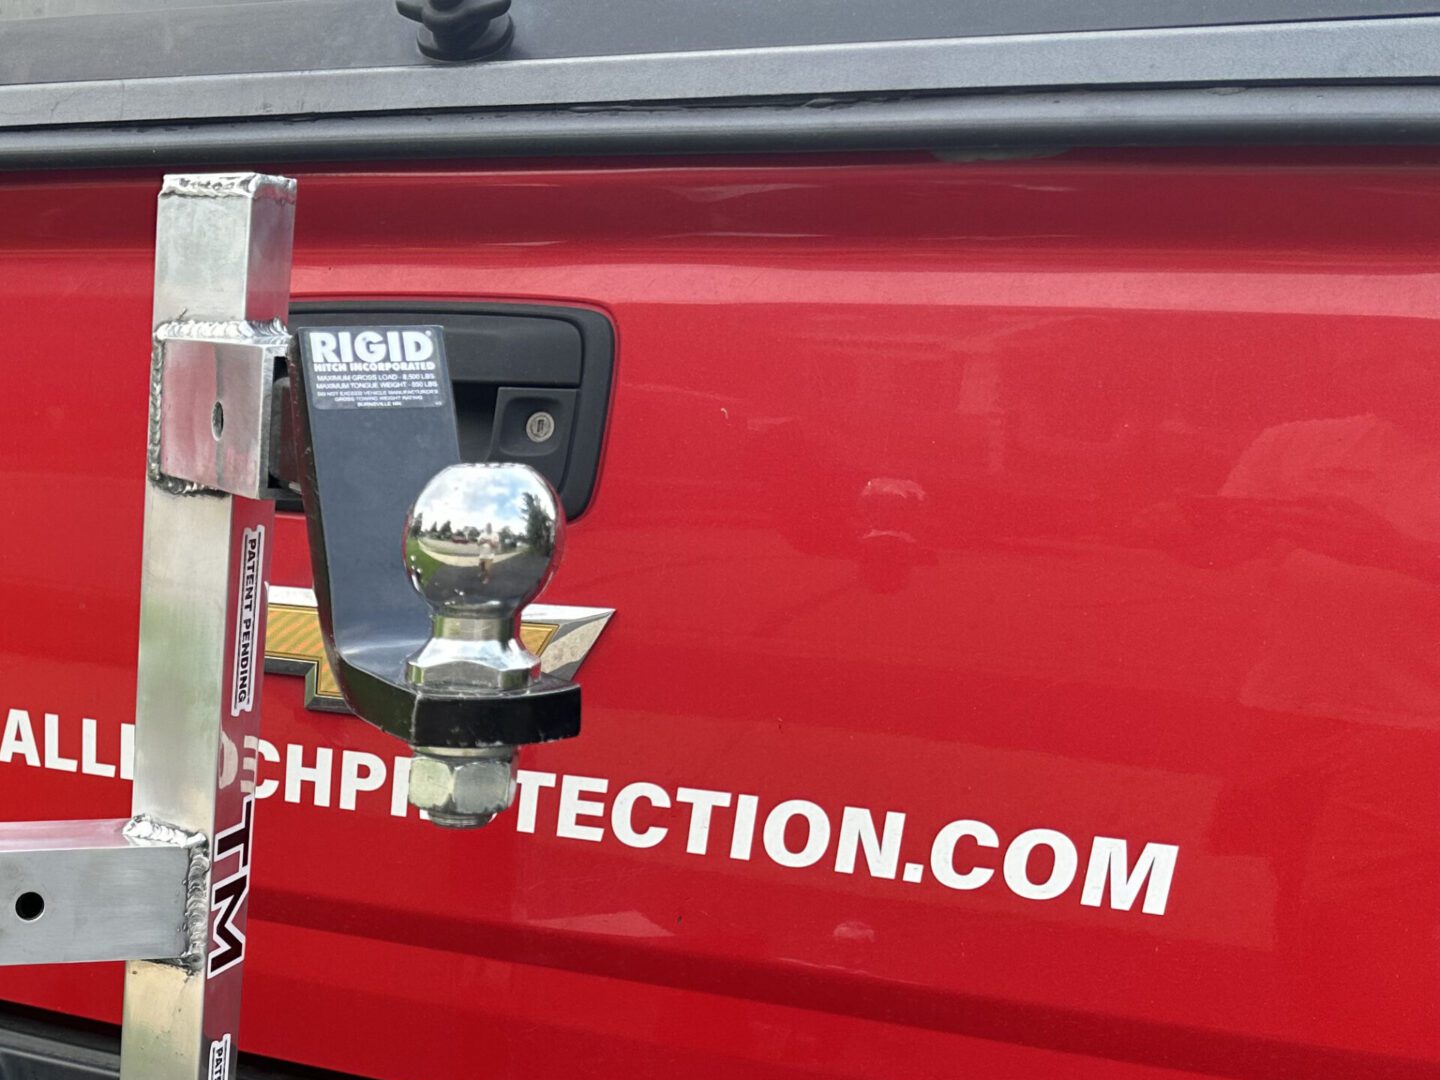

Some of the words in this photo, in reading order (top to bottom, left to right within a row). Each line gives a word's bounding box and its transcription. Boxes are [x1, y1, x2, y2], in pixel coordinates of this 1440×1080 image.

[310, 331, 433, 363] RIGID
[314, 362, 348, 372] HITCH
[350, 361, 436, 372] INCORPORATED
[378, 373, 398, 381] LOAD
[243, 538, 257, 612] PATENT
[238, 618, 252, 703] PENDING
